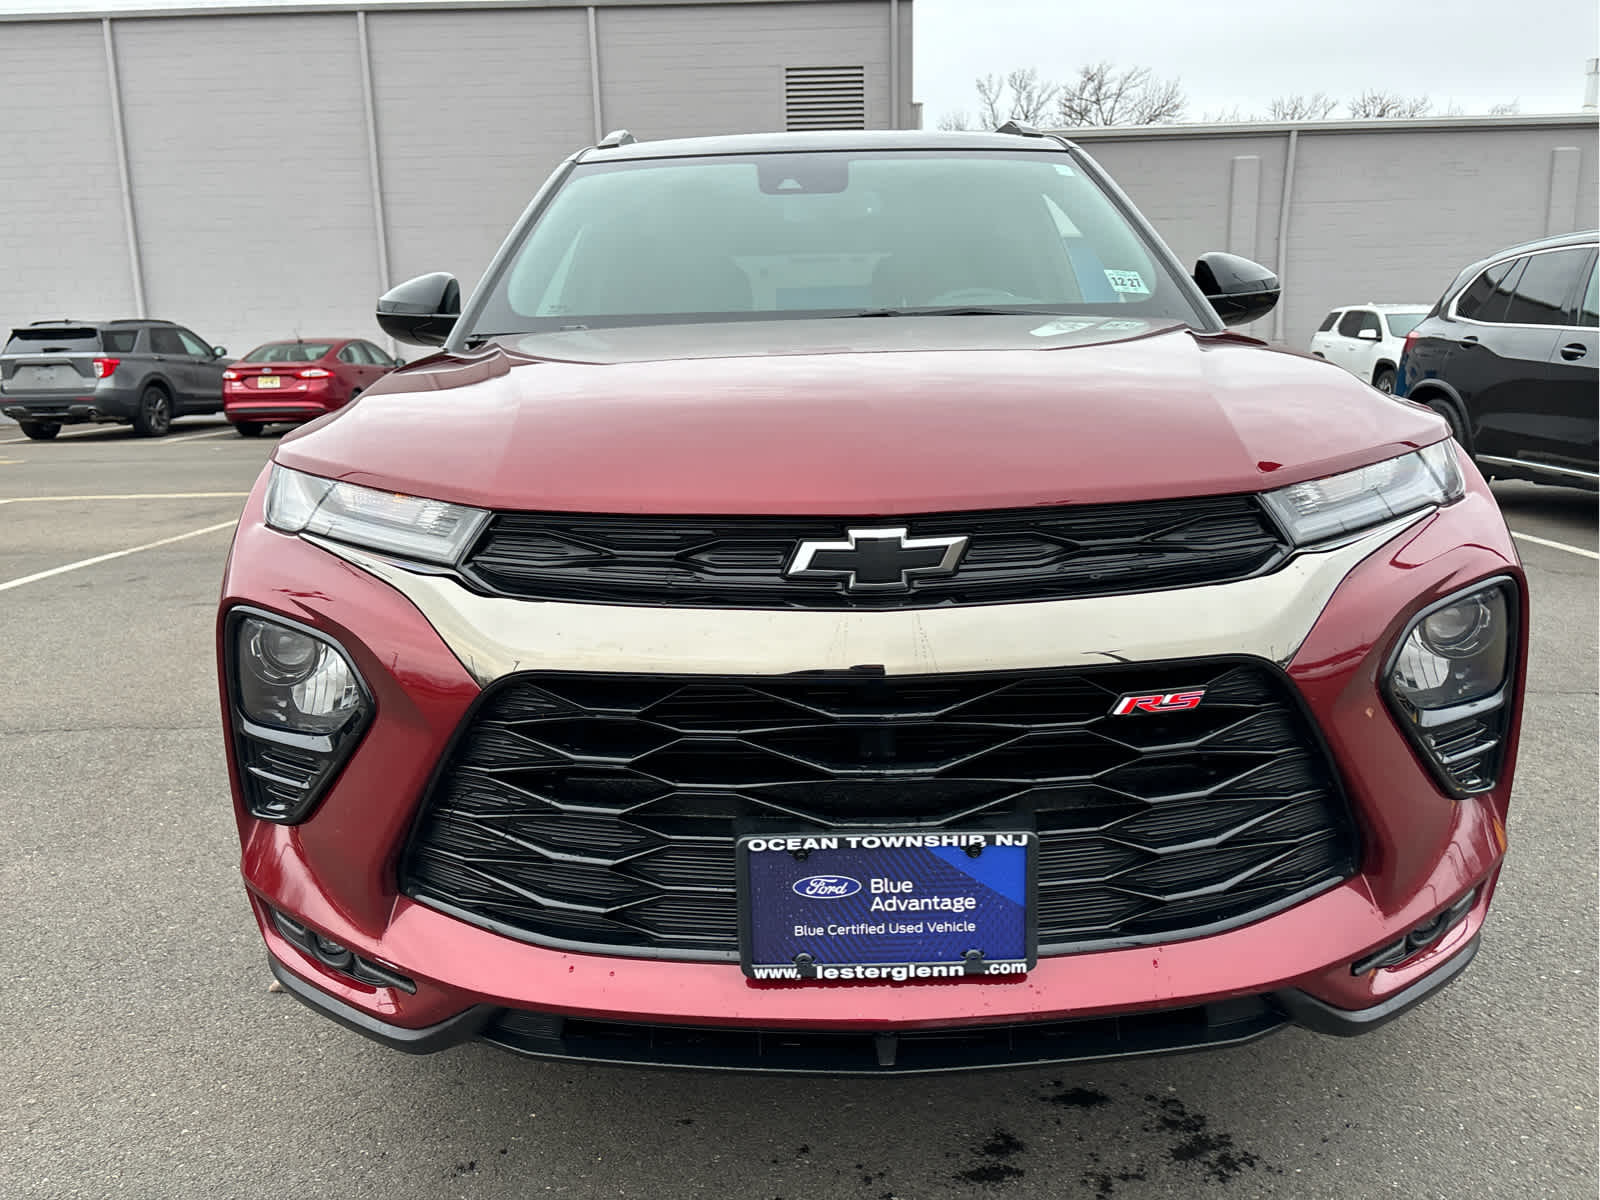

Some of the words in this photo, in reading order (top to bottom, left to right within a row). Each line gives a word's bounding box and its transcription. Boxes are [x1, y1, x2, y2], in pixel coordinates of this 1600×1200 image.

[1113, 690, 1205, 715] RS
[748, 837, 838, 851] OCEAN
[995, 834, 1028, 847] NJ
[805, 878, 848, 895] Ford
[870, 878, 913, 894] Blue
[870, 896, 976, 913] Advantage
[794, 924, 824, 937] Blue
[827, 923, 886, 936] Certified
[889, 922, 923, 935] Used
[926, 921, 976, 934] Vehicle
[753, 967, 801, 979] www.
[816, 964, 965, 981] lesterglenn
[984, 962, 1027, 975] .com
